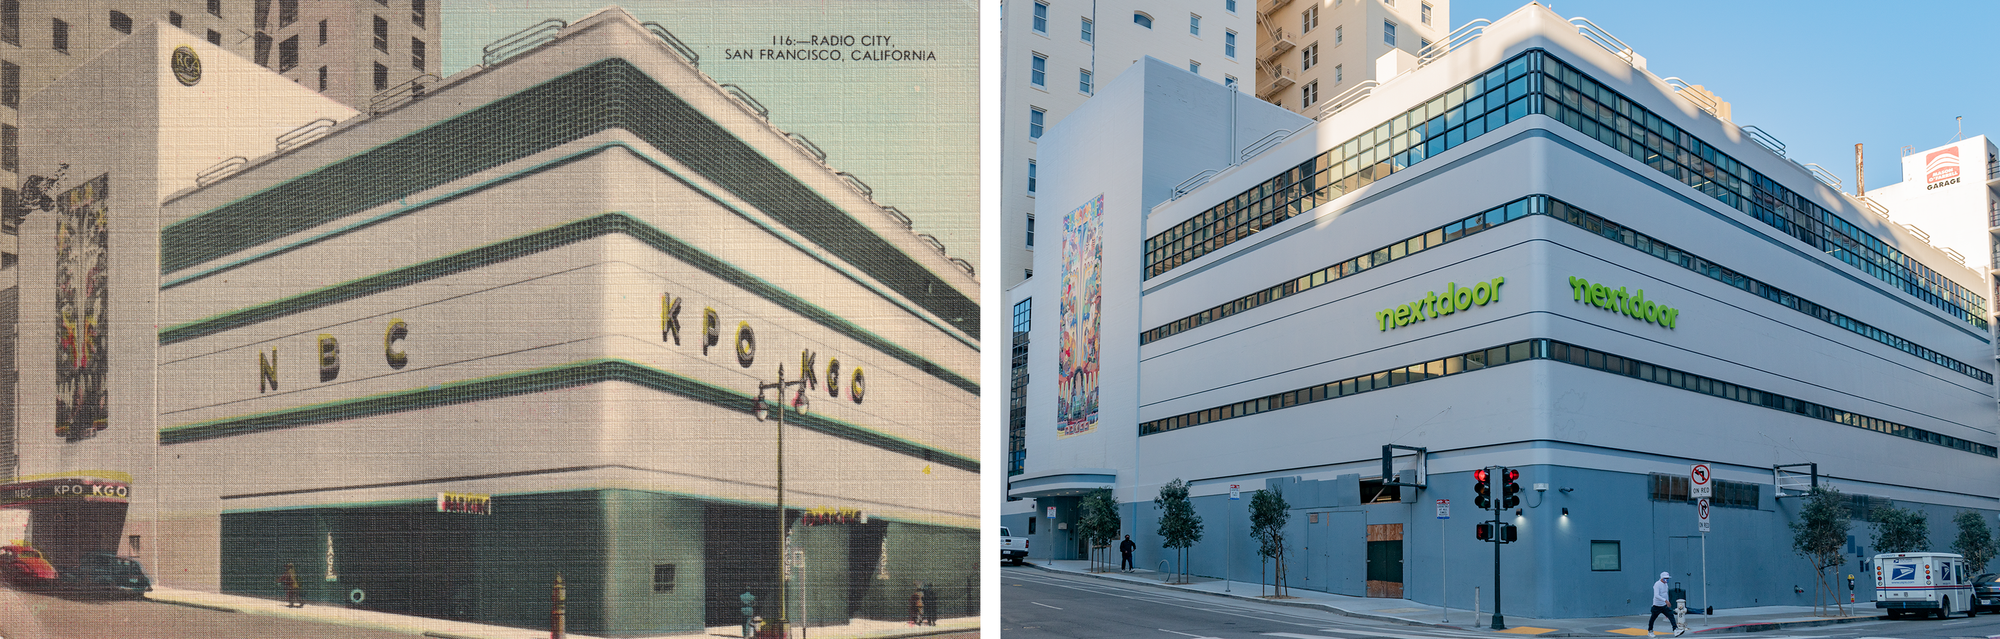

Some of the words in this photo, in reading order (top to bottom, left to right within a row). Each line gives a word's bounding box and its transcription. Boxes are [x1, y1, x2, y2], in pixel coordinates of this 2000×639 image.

[175, 52, 200, 74] RCA
[1932, 167, 1954, 177] MASON
[1926, 177, 1961, 191] GARAGE
[1375, 276, 1505, 332] nextdoor
[1568, 275, 1679, 330] nextdoor
[660, 291, 757, 369] KPO
[800, 348, 866, 405] KGO
[54, 484, 83, 496] KPO
[92, 484, 128, 498] KGO
